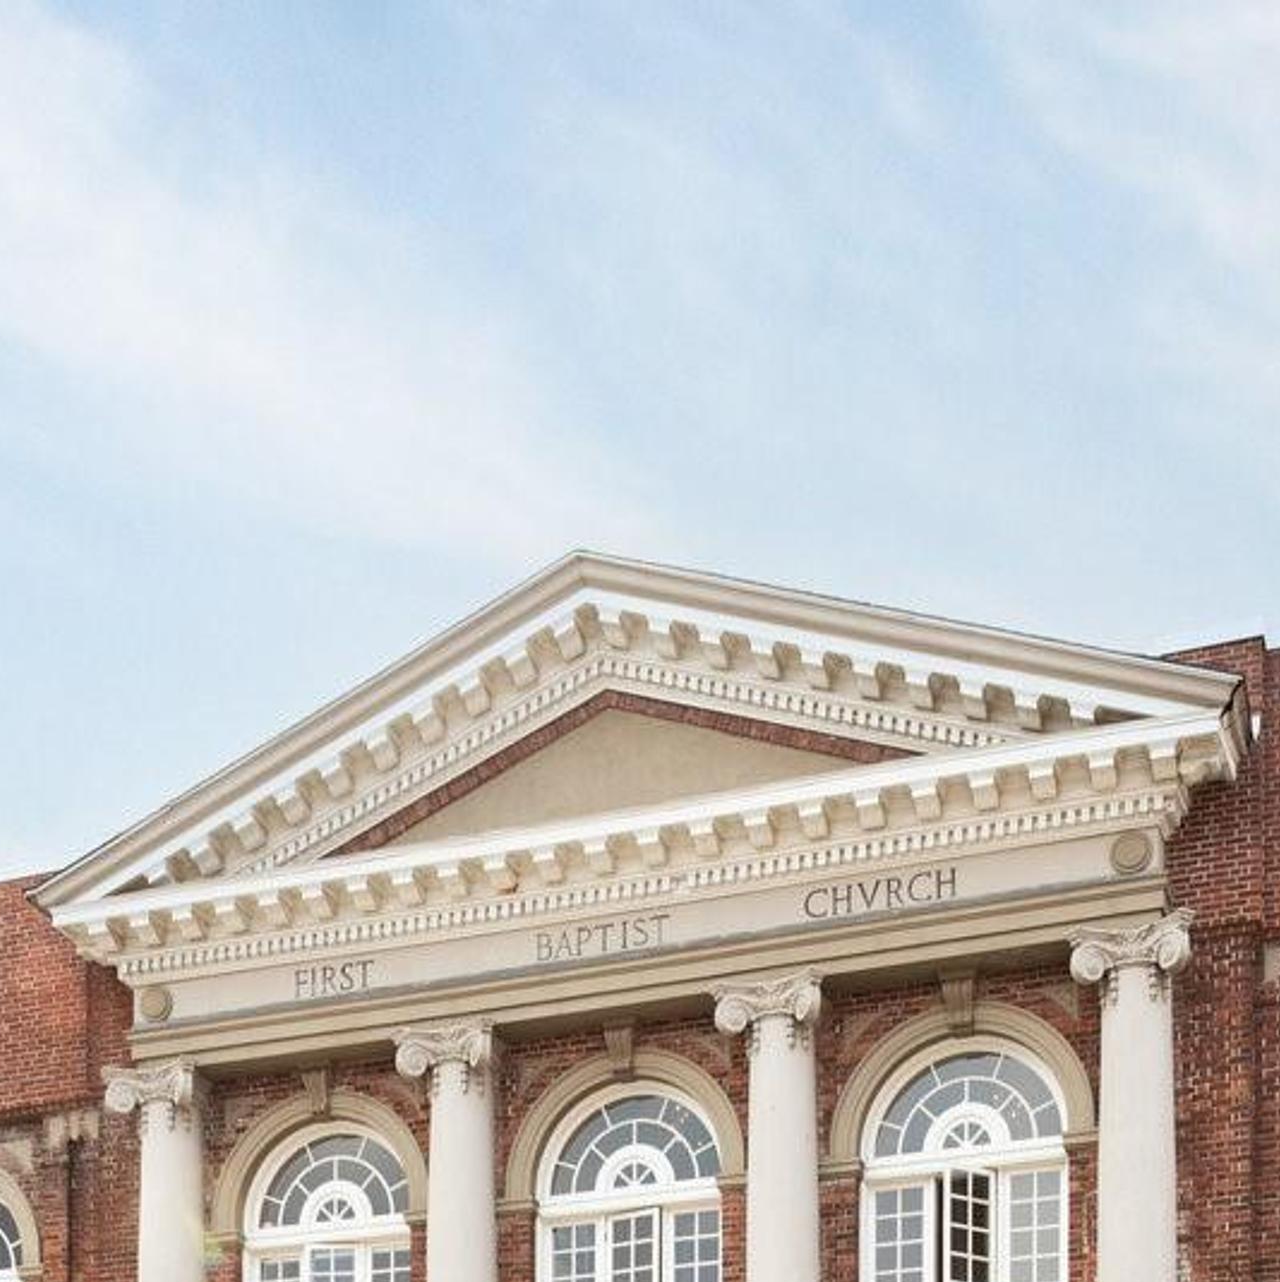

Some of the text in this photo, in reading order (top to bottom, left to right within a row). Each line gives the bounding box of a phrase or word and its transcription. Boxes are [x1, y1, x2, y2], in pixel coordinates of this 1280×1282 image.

[294, 867, 956, 998] FIRST BAPTIST CHVRCH
